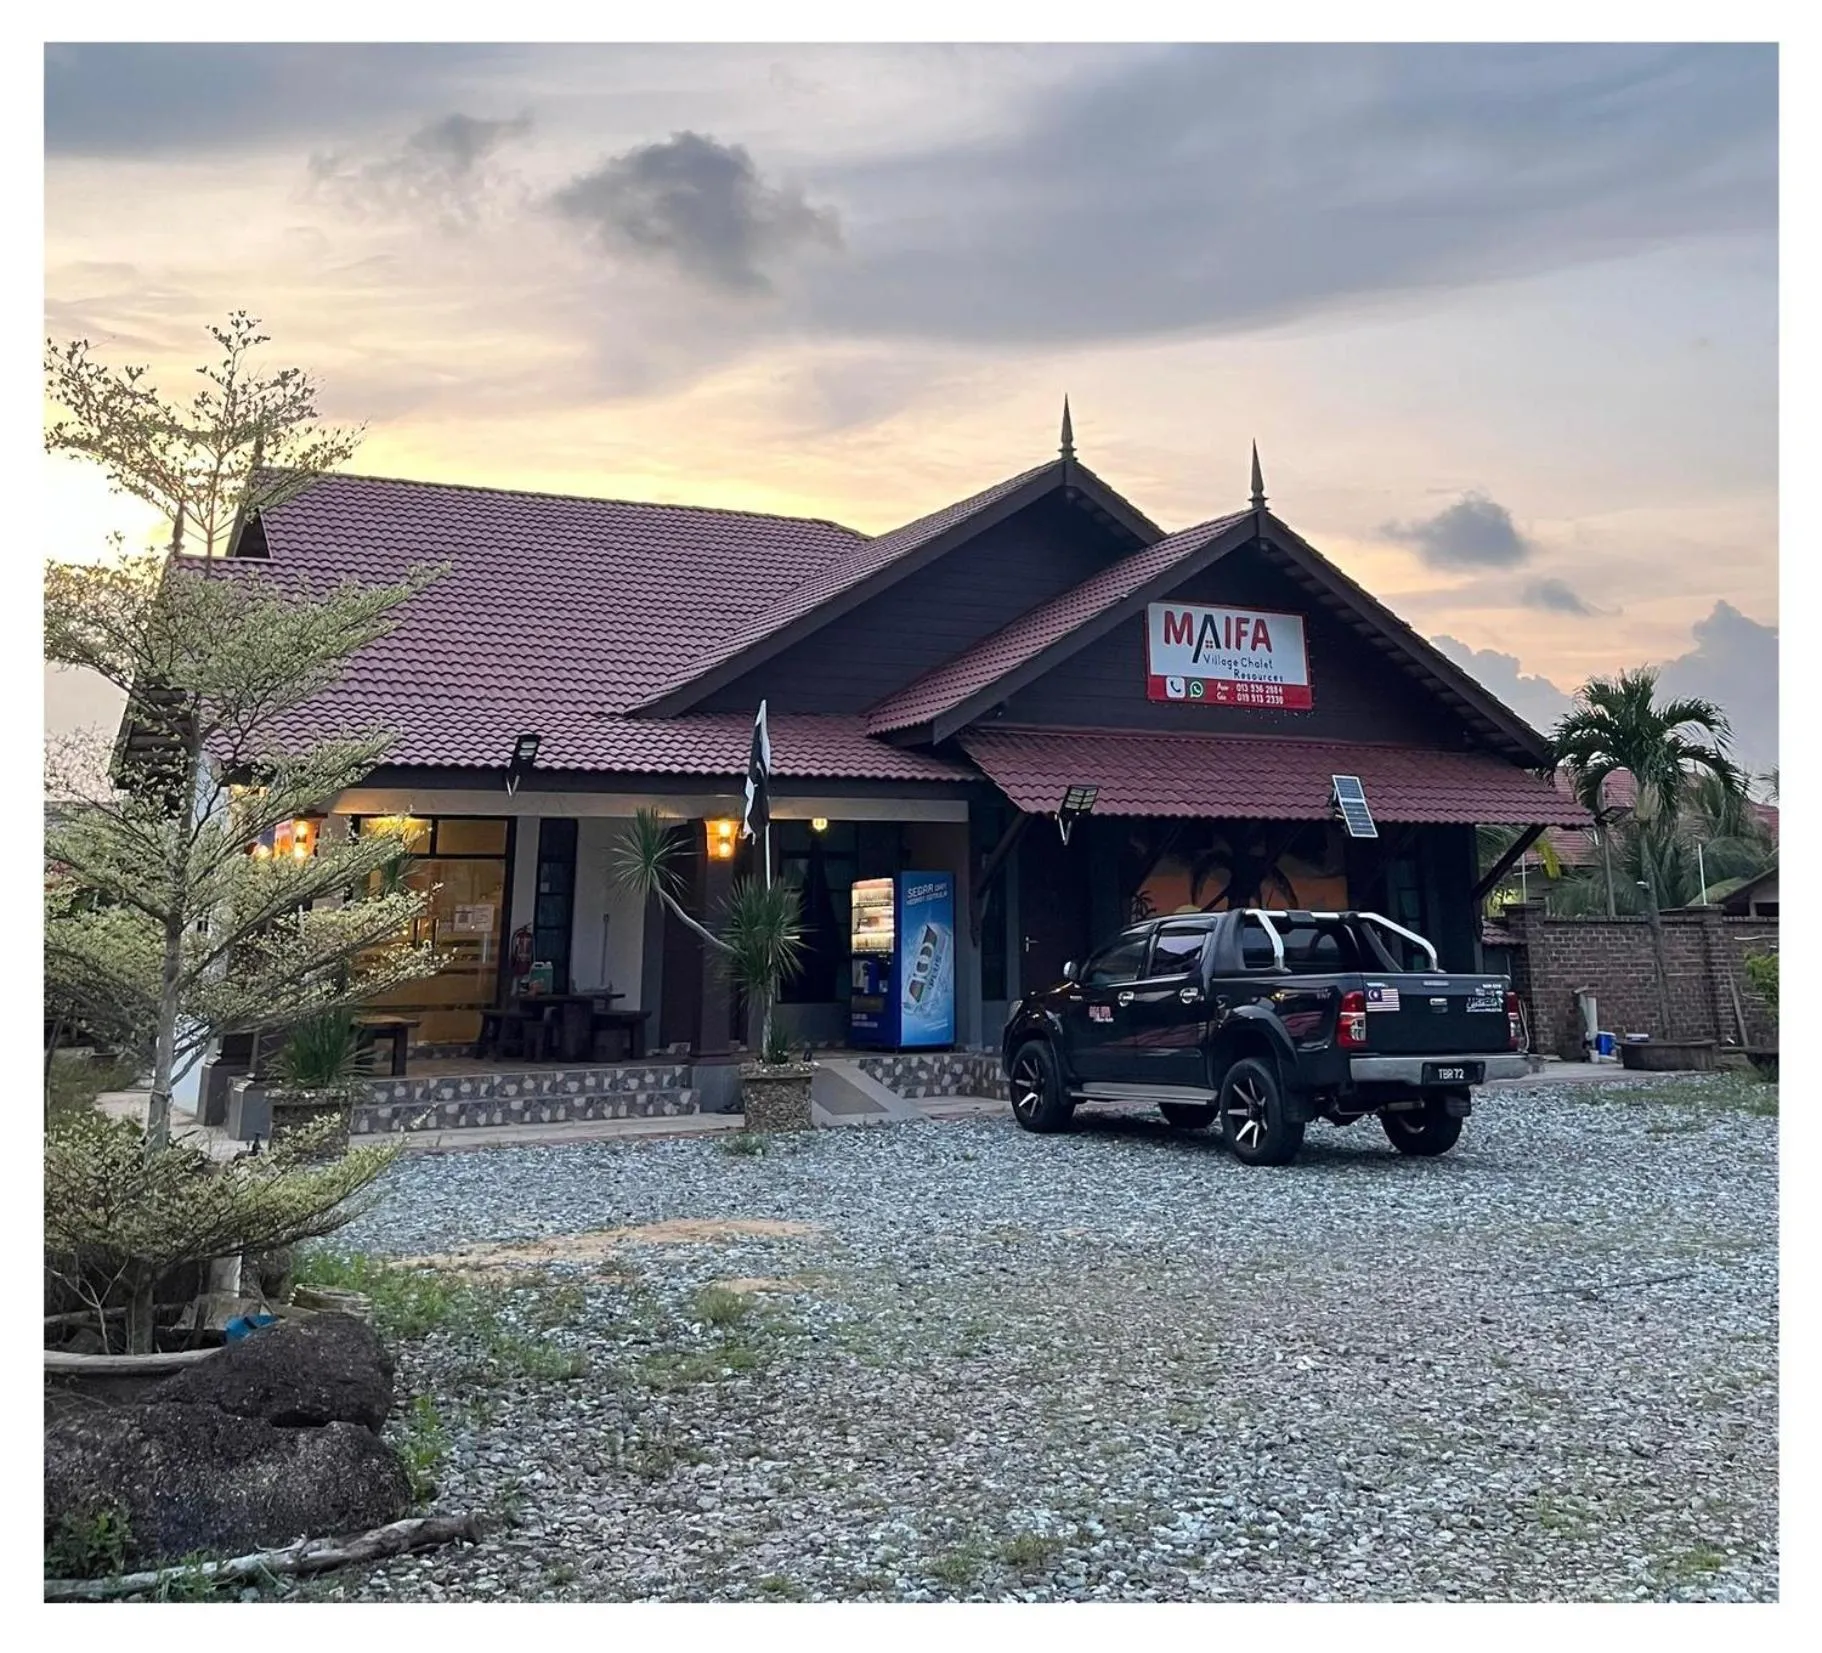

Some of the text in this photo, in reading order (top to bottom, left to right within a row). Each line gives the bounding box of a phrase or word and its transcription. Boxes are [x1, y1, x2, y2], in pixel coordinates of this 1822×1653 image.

[1164, 610, 1272, 664] MAIFA
[1203, 653, 1274, 670] Village Chalet
[1233, 669, 1284, 682] Resources
[1453, 1068, 1465, 1080] 72
